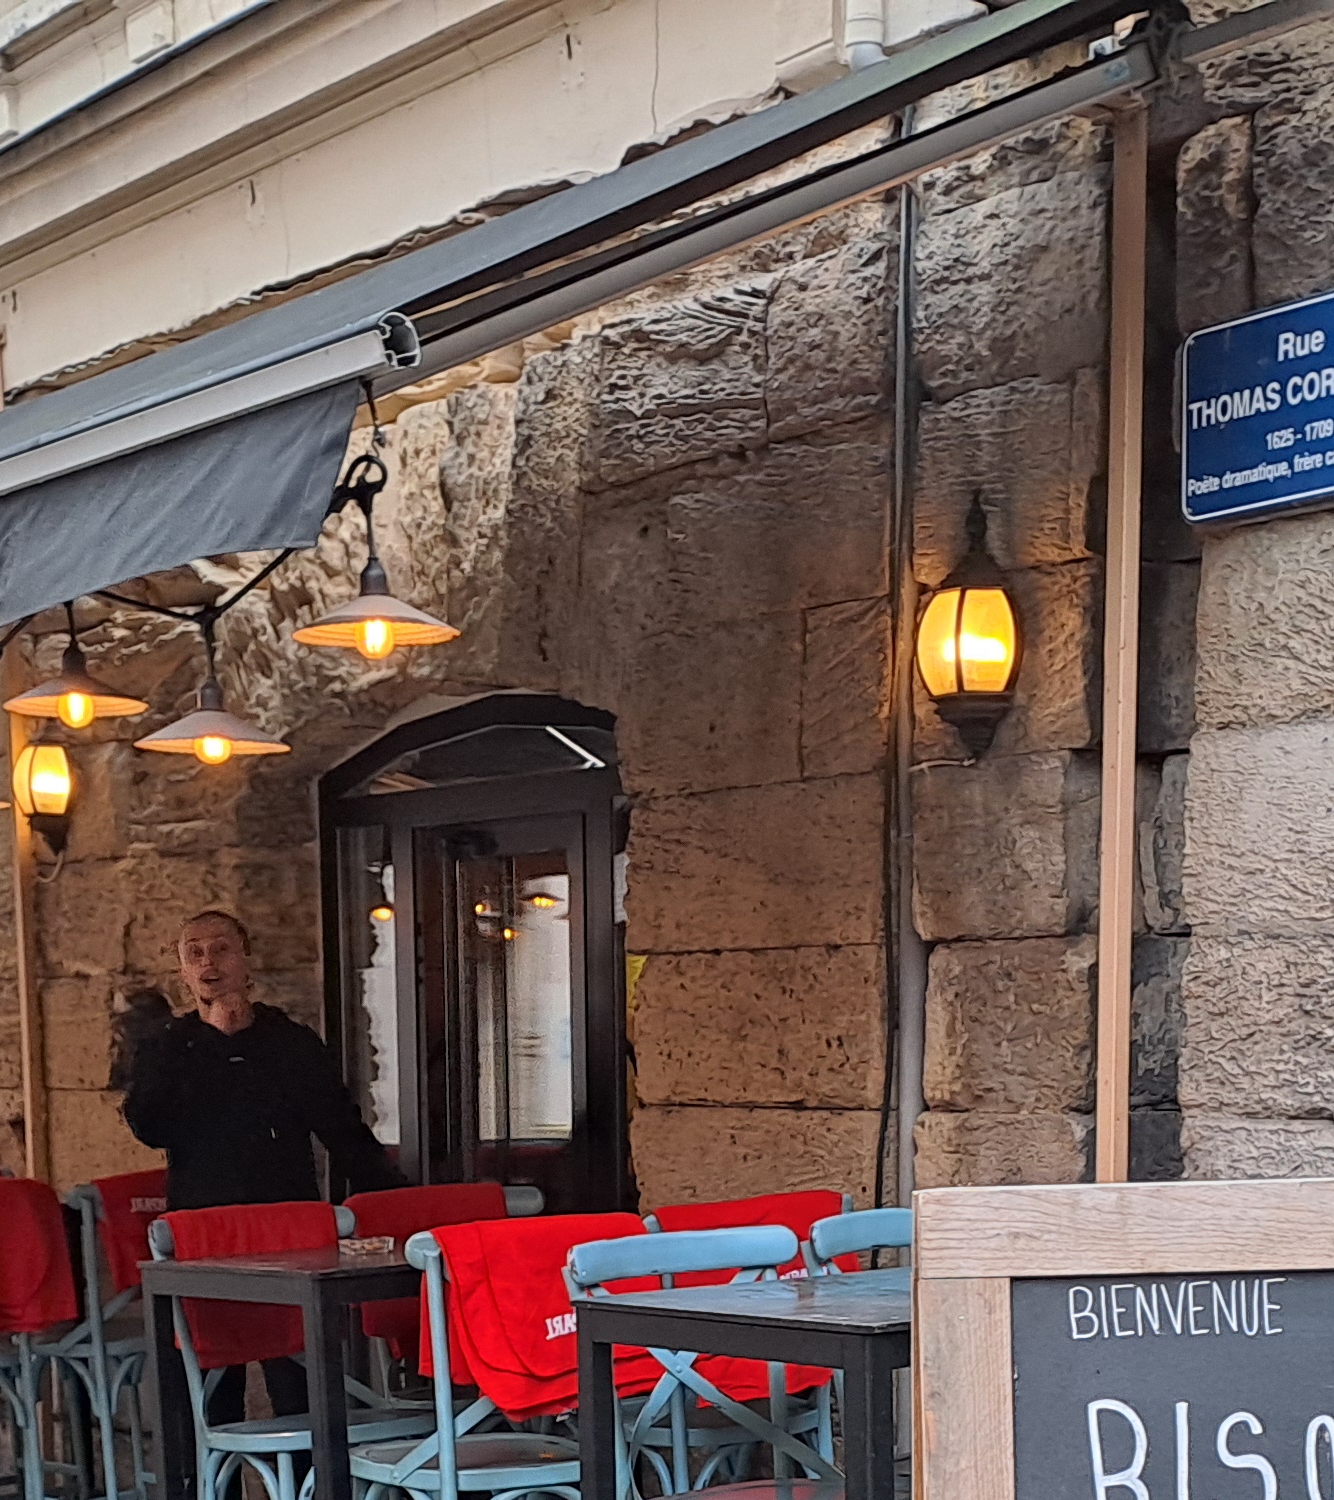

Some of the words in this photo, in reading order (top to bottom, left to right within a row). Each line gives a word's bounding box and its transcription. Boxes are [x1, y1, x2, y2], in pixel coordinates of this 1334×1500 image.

[1277, 329, 1325, 361] Rue
[1188, 382, 1282, 430] THOMAS
[1068, 1277, 1286, 1340] BIENVENUE
